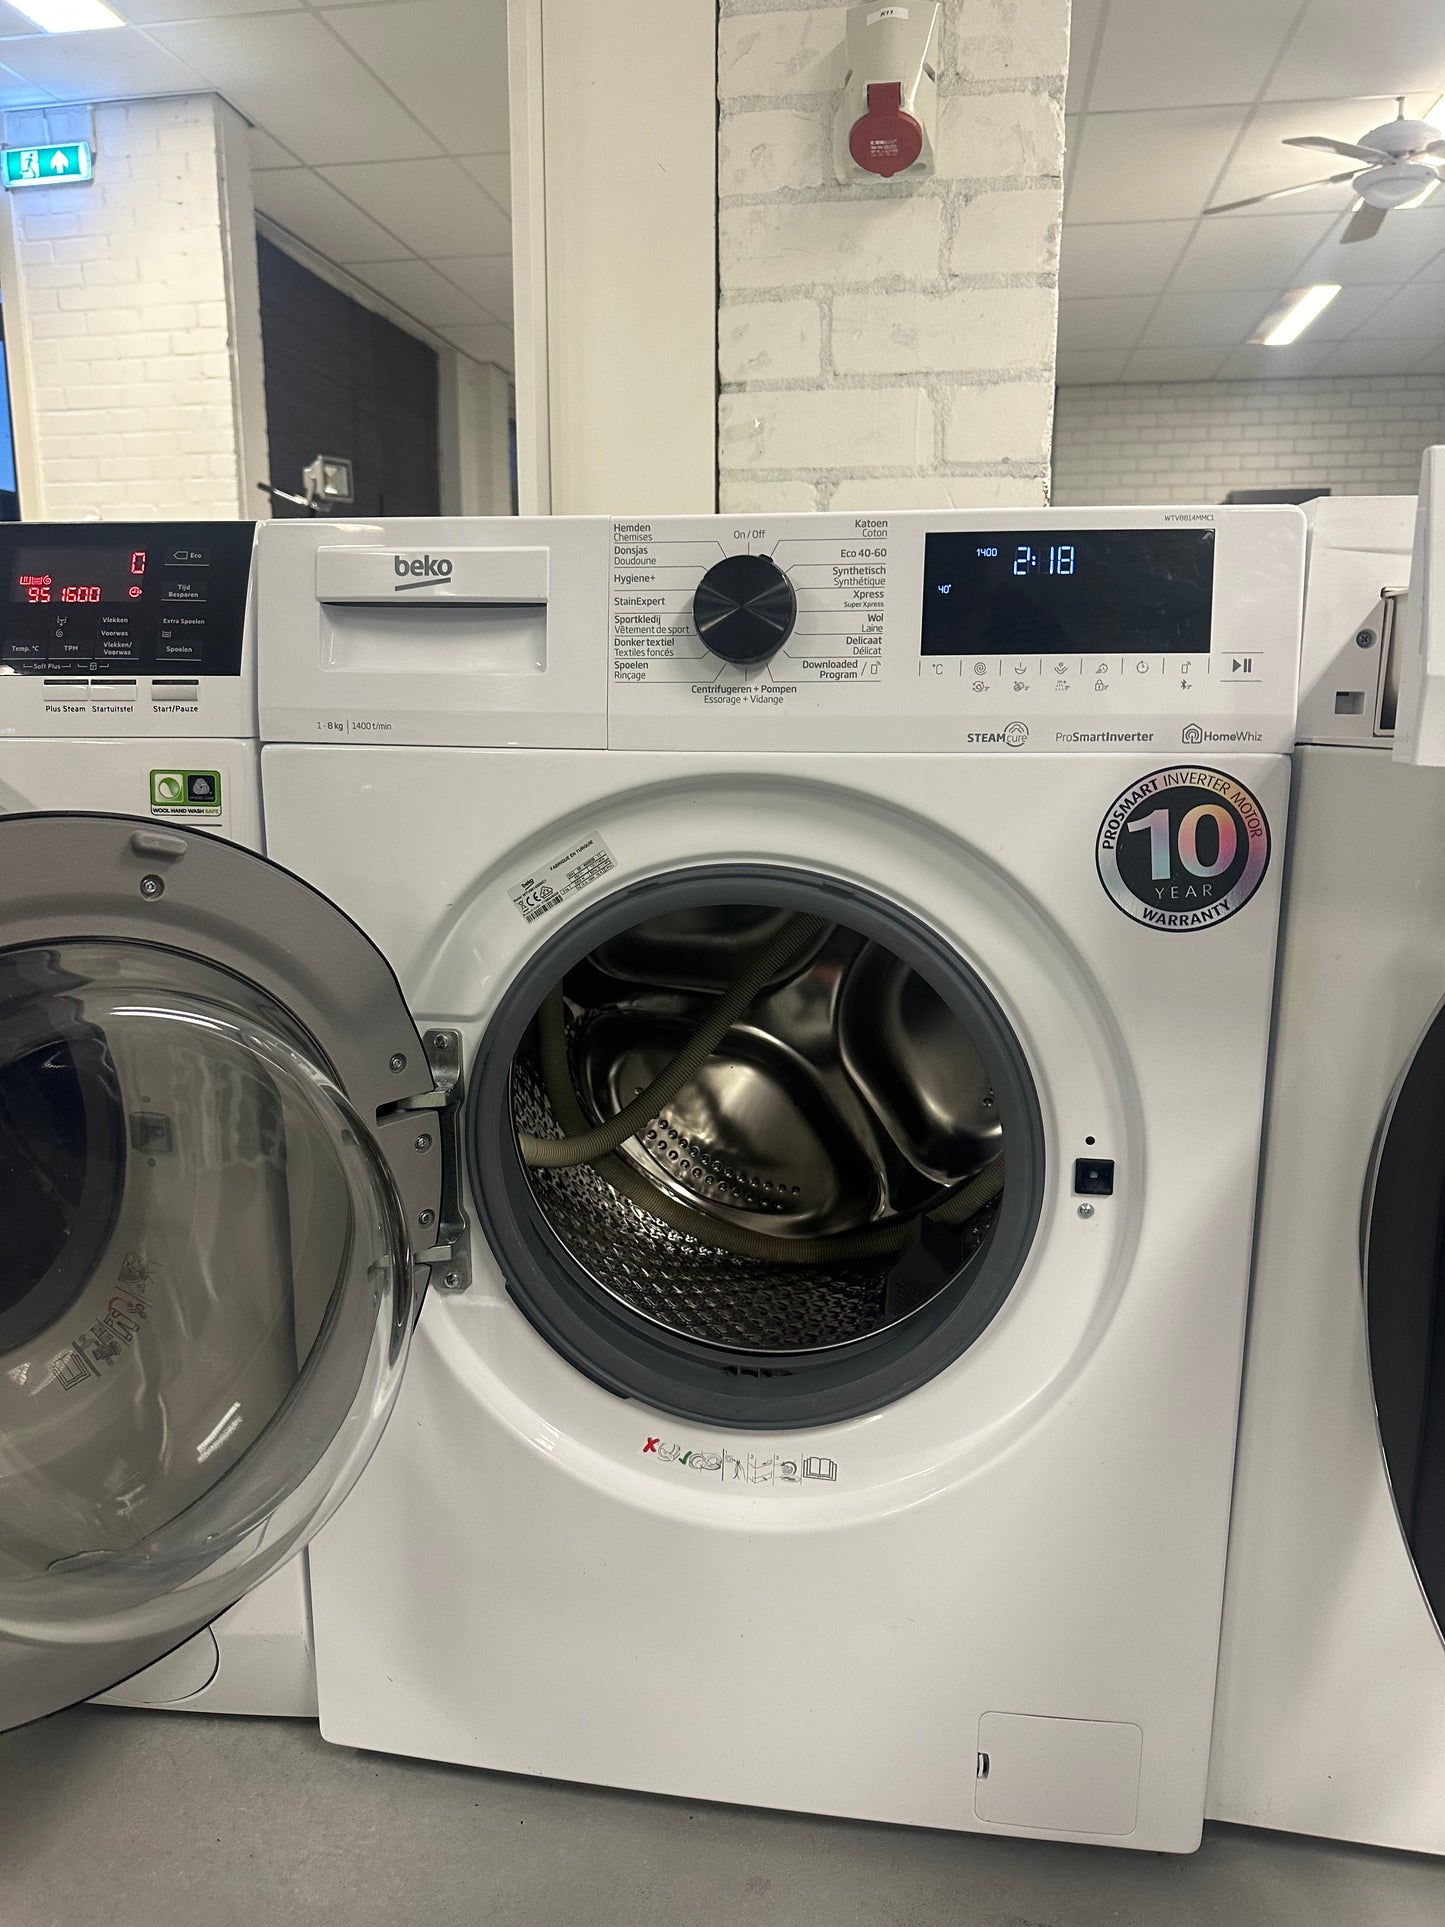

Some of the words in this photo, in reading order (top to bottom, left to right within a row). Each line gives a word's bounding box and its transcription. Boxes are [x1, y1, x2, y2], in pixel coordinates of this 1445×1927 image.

[614, 523, 651, 533] Hemden
[854, 519, 888, 528] Katoen
[614, 533, 653, 541] Chemises
[733, 530, 746, 539] On
[752, 529, 766, 539] Off
[862, 528, 888, 537] Coton
[614, 546, 648, 556] Donsjas
[840, 549, 856, 558] Eco
[858, 548, 888, 558] 40-60
[976, 547, 998, 557] 1400
[394, 554, 453, 577] beko
[614, 556, 657, 565] Doudoune
[1013, 546, 1075, 576] 2:18
[832, 566, 886, 578] Synthetisch
[614, 574, 656, 585] Hygiene+
[834, 577, 886, 588] Synthétique
[178, 584, 191, 592] Tijd
[28, 586, 51, 603] 95
[62, 586, 101, 603] 1600
[168, 591, 199, 599] Besparen
[853, 589, 884, 601] Xpress
[614, 597, 666, 607] StainExpert
[844, 601, 862, 609] Super
[614, 615, 661, 625] Sportkledij
[868, 613, 884, 622] Wol
[614, 625, 655, 634] Vêtement
[656, 625, 667, 634] de
[668, 626, 690, 636] sport
[861, 624, 884, 633] Laine
[614, 638, 644, 647] Donker
[646, 638, 675, 647] textiel
[846, 636, 882, 645] Delicaat
[104, 648, 132, 656] Voorwas
[614, 648, 646, 657] Textiles
[646, 647, 674, 657] foncés
[852, 645, 882, 655] Délicat
[614, 661, 649, 671] Spoelen
[802, 660, 858, 669] Downloaded
[614, 671, 646, 681] Rinçage
[820, 671, 858, 681] Program
[691, 685, 752, 695] Centrifugeren
[760, 685, 797, 695] Pompen
[704, 695, 741, 705] Essorage
[750, 695, 784, 705] Vidange
[45, 705, 61, 713] Plus
[62, 705, 86, 713] Steam
[92, 705, 134, 713] Startuitstel
[152, 705, 199, 713] Start/Pauze
[334, 721, 344, 732] kg
[352, 721, 372, 730] 1400
[1056, 731, 1154, 743] ProSmartInverter
[1204, 731, 1262, 743] HomeWhiz
[1102, 778, 1159, 850] PROSMART
[1163, 771, 1232, 796] INVERTER
[1230, 791, 1263, 839] MOTOR
[1127, 803, 1238, 881] 10
[1154, 883, 1213, 900] YEAR
[1143, 897, 1231, 927] WARRANTY
